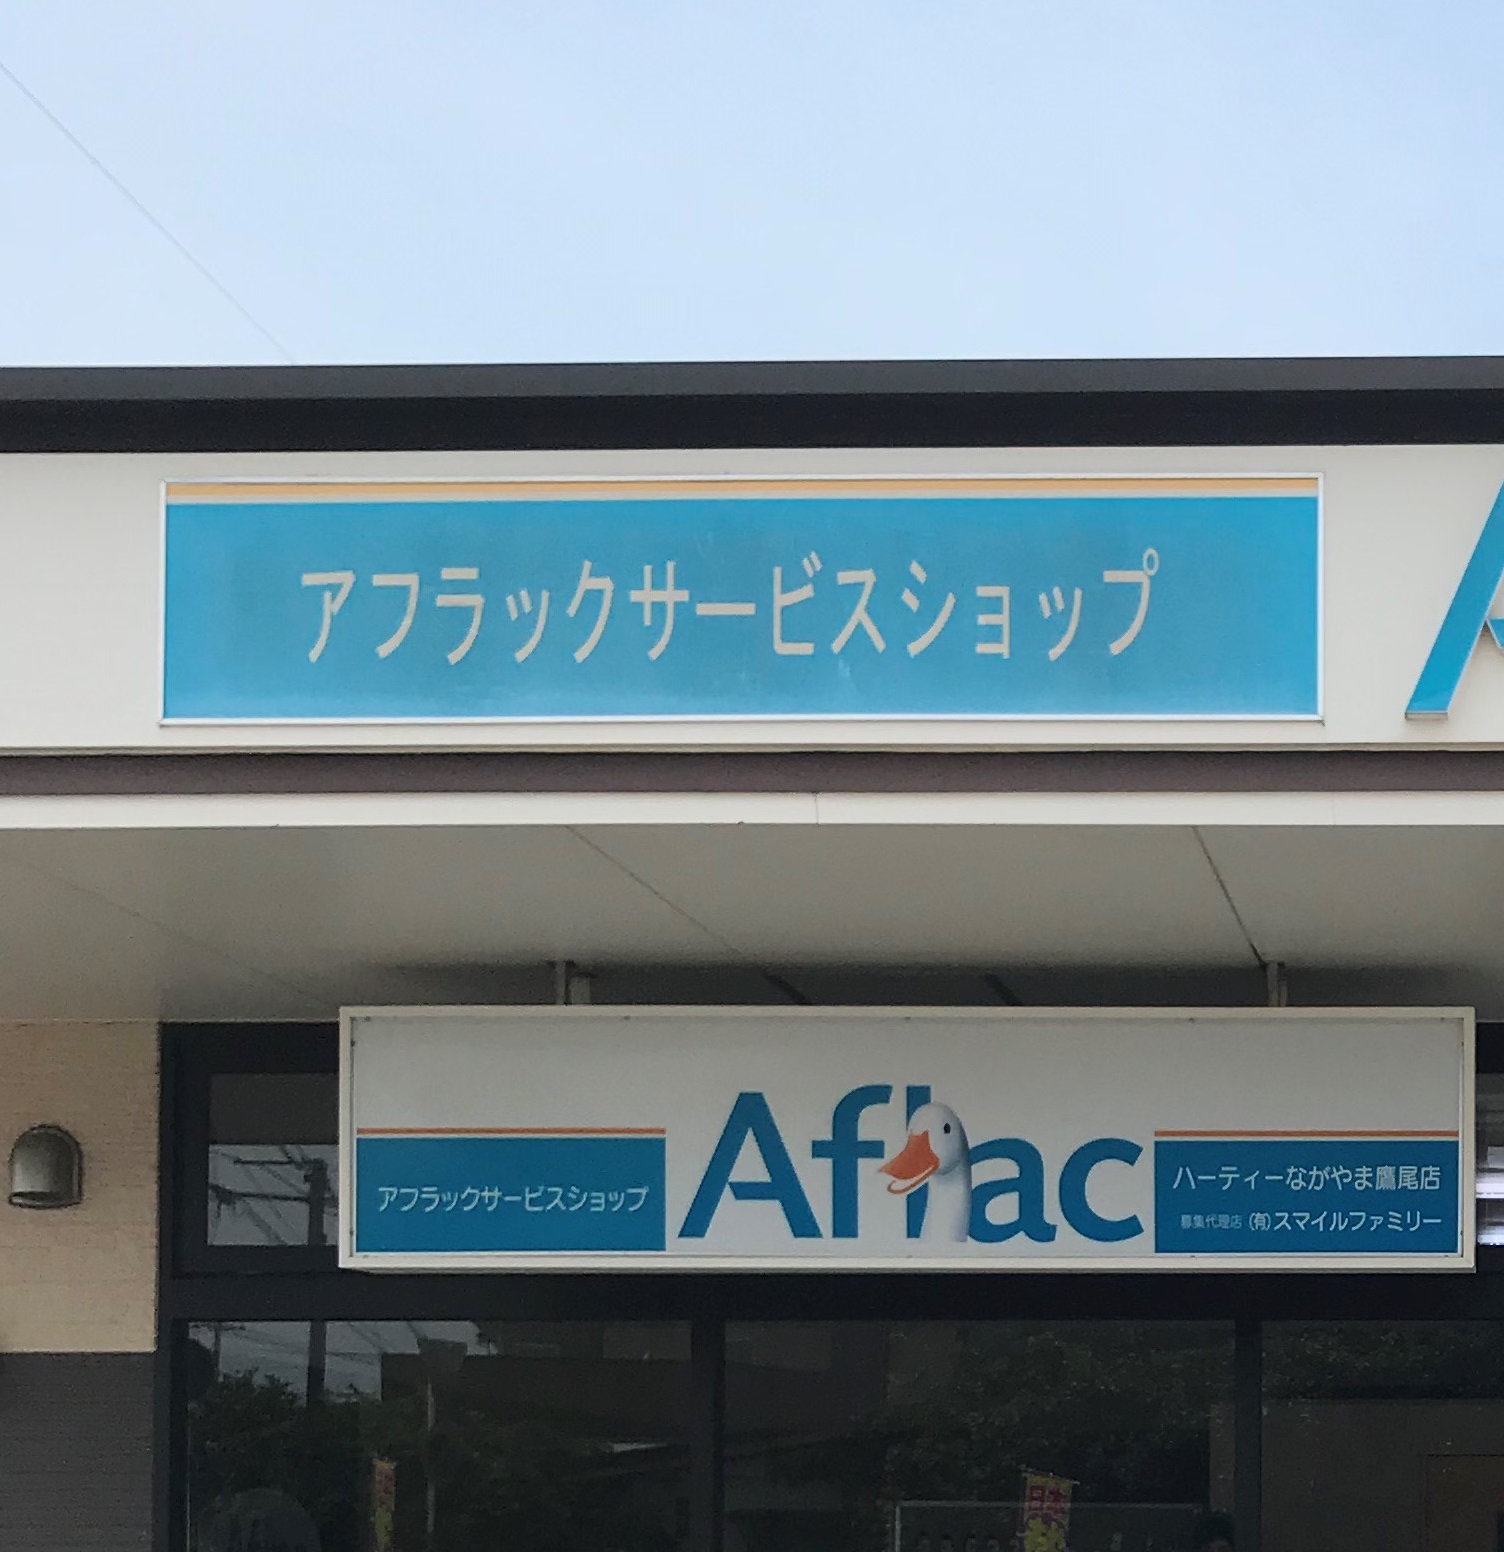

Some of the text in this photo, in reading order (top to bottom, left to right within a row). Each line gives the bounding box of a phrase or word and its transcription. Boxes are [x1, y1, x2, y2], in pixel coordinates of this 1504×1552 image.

[300, 546, 1160, 666] アフラックサービスショップ
[1171, 1164, 1442, 1191] ハーティーながやま鷹尾店
[377, 1185, 650, 1213] アフラックサービスショップ
[1180, 1210, 1442, 1232] 募集代理店 (有)スマイルファミリー
